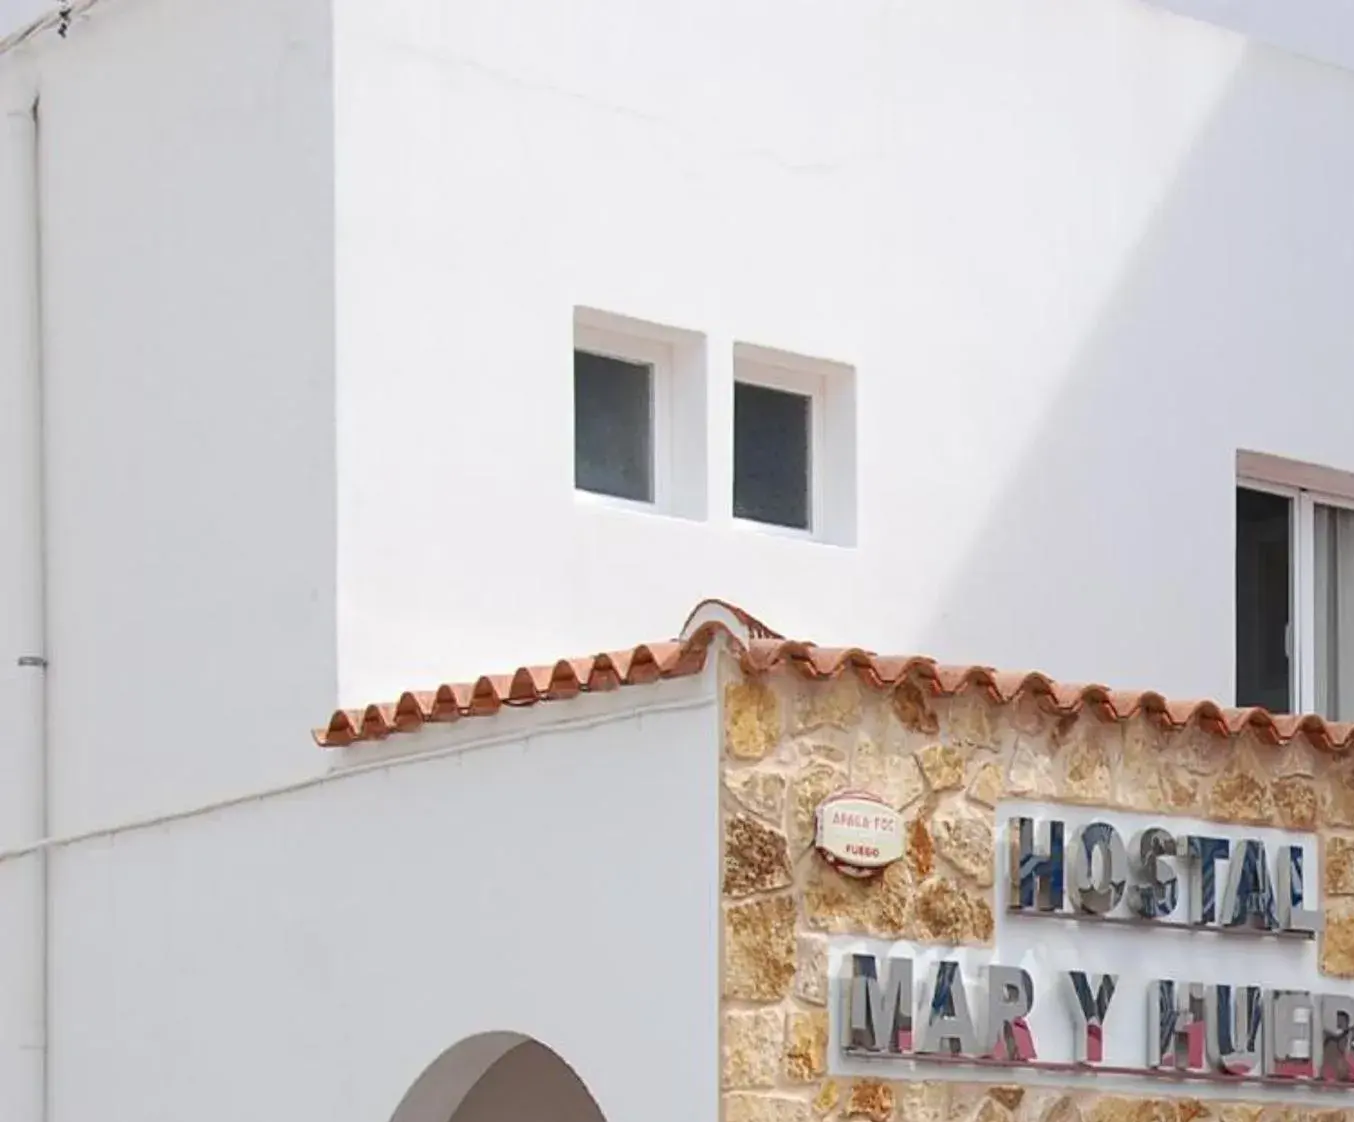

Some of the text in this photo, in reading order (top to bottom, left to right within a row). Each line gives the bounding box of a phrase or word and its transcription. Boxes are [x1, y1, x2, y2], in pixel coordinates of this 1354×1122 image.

[1008, 816, 1322, 938] HOSTAL
[842, 953, 1037, 1061] MAR
[1070, 970, 1119, 1062] Y
